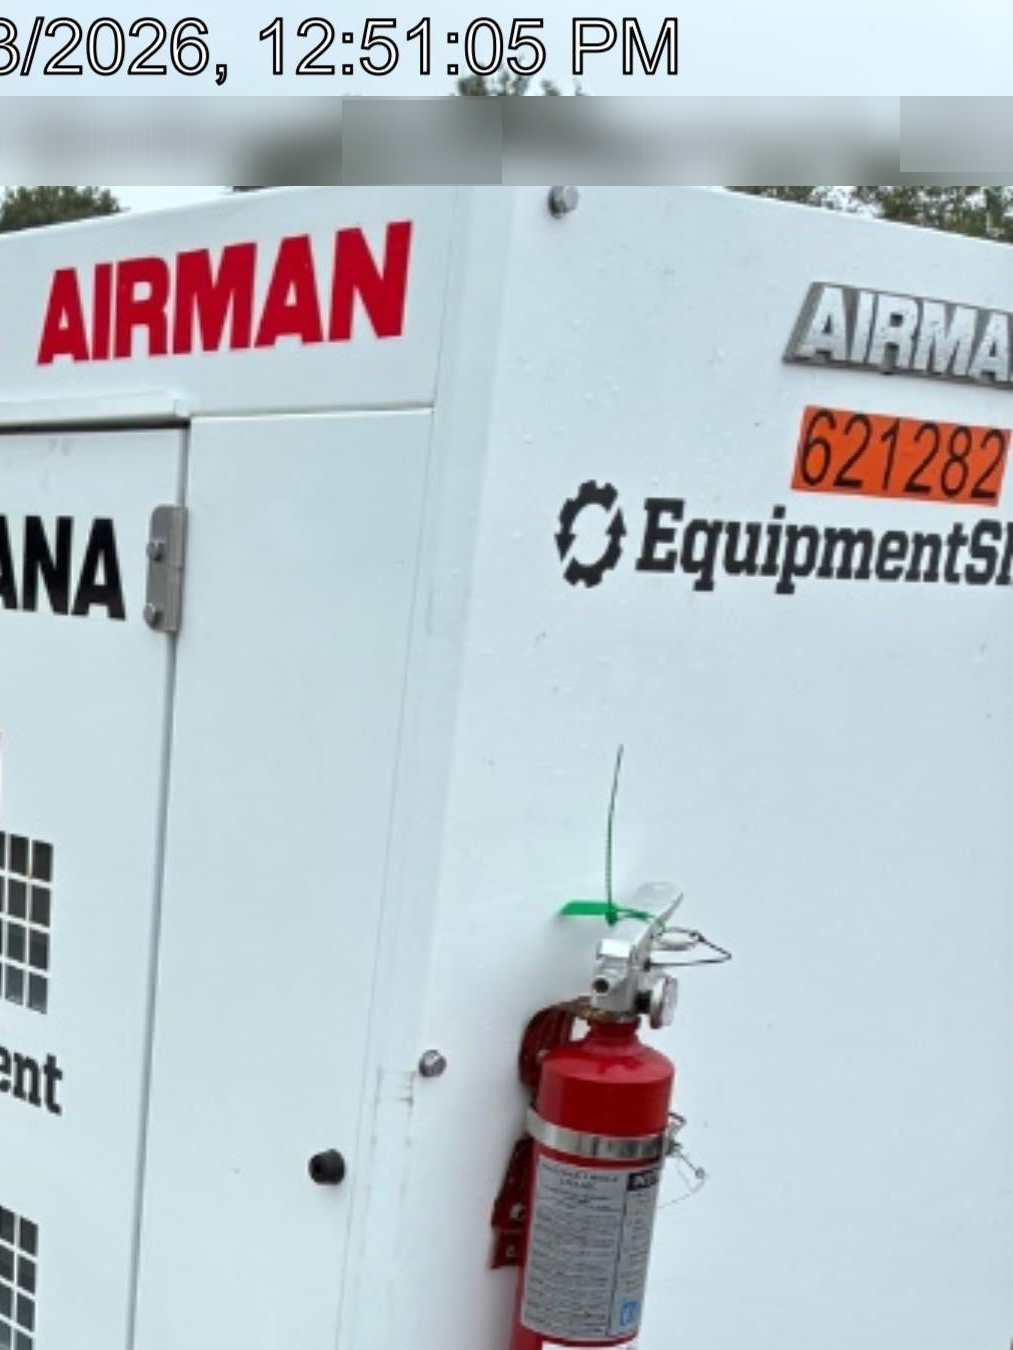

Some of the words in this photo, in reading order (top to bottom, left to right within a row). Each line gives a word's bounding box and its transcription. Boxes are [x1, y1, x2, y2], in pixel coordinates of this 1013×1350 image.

[37, 220, 412, 366] AIRMAN
[793, 285, 1013, 382] AIRMA
[799, 408, 1006, 499] 621282
